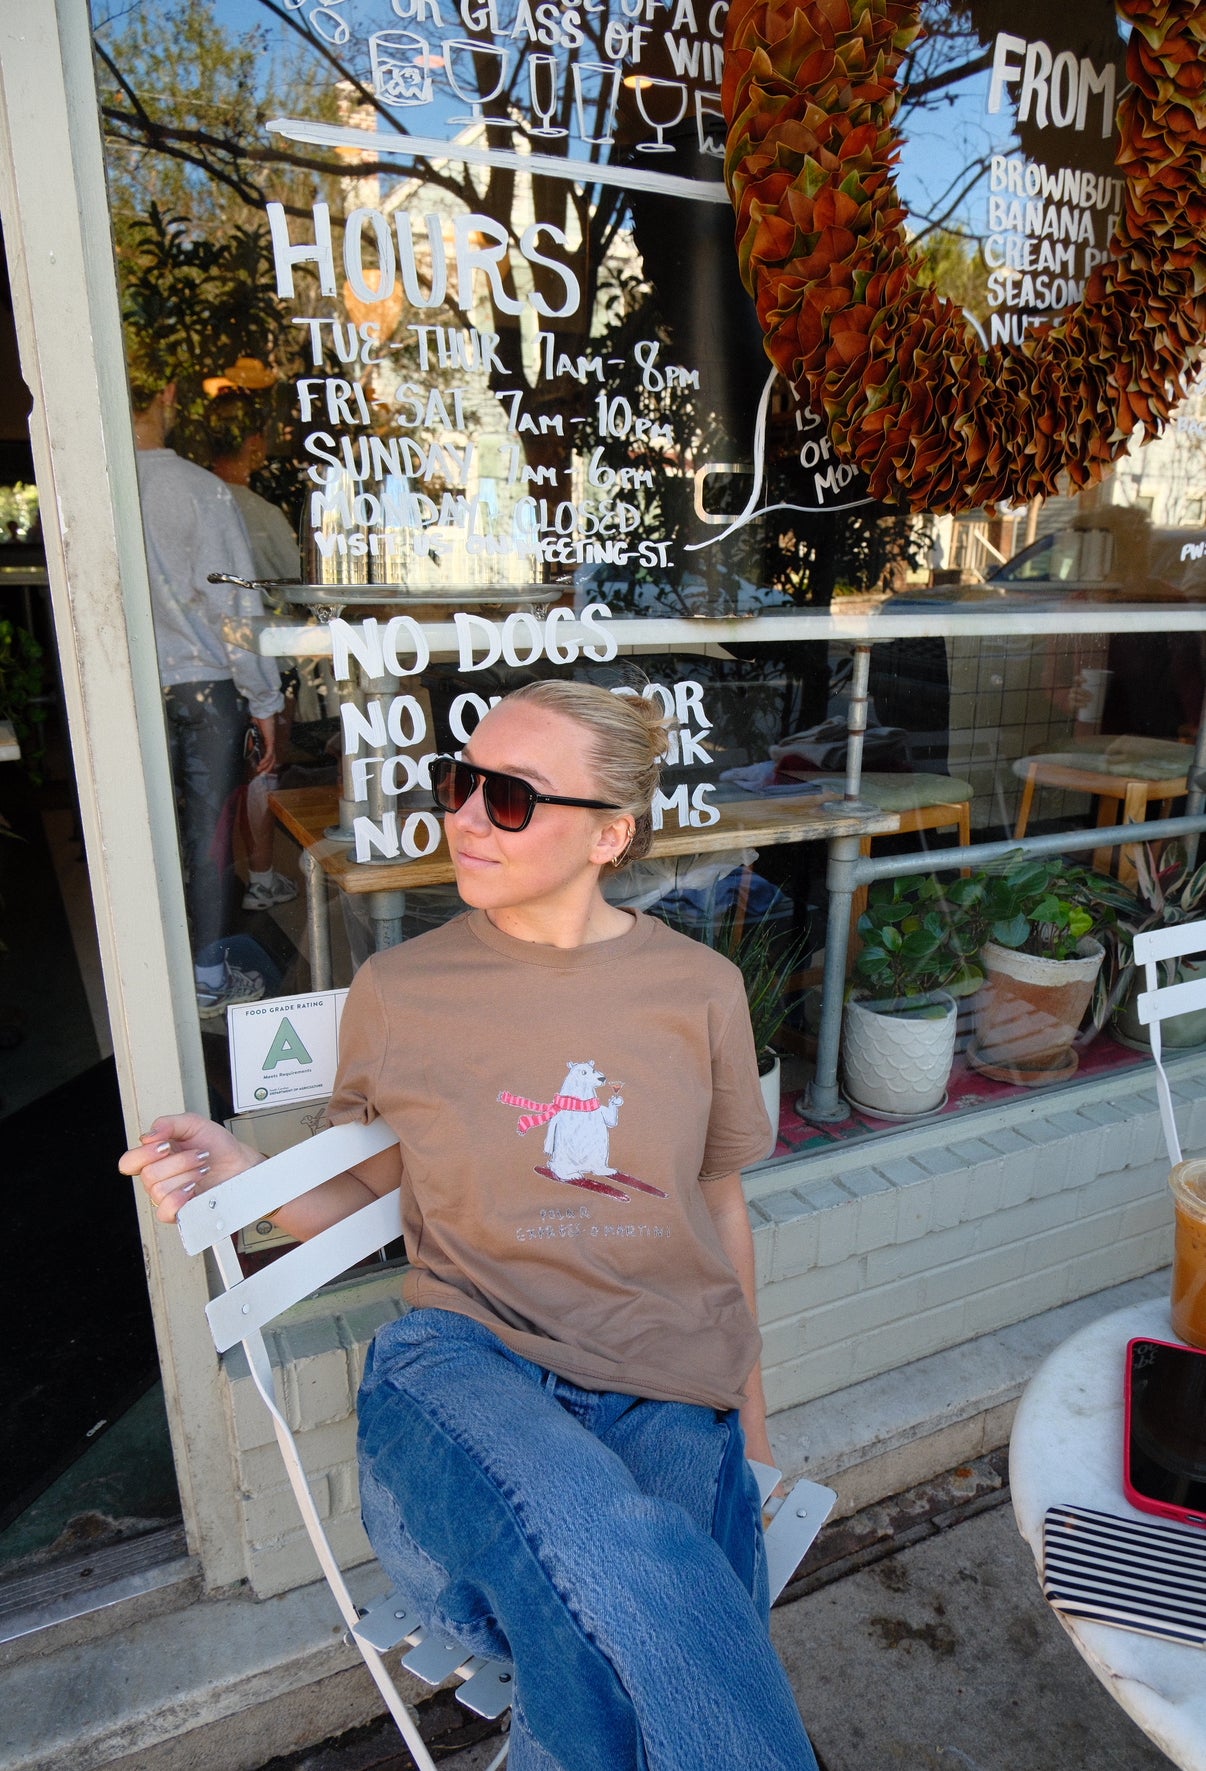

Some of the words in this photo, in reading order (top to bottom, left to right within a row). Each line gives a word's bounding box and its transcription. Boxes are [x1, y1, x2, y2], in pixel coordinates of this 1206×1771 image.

[460, 0, 585, 48] GLASS
[604, 21, 653, 63] OF
[987, 32, 1116, 139] FROM
[989, 196, 1095, 247] BANANA
[265, 202, 581, 318] HOURS
[984, 233, 1075, 278] CREAM
[304, 431, 476, 485] SUNDAY
[311, 491, 480, 534] MONDAY
[515, 495, 641, 535] CLOSED
[313, 531, 397, 557] VISIT
[412, 532, 452, 557] US
[329, 615, 430, 681] NO
[453, 603, 618, 672] DOGS
[340, 694, 427, 755] NO
[353, 811, 441, 863] NO
[245, 1008, 267, 1017] FOOD
[269, 1004, 295, 1013] GRADE
[296, 1000, 324, 1009] RATING
[262, 1016, 313, 1071] A
[279, 1068, 313, 1077] Requirements
